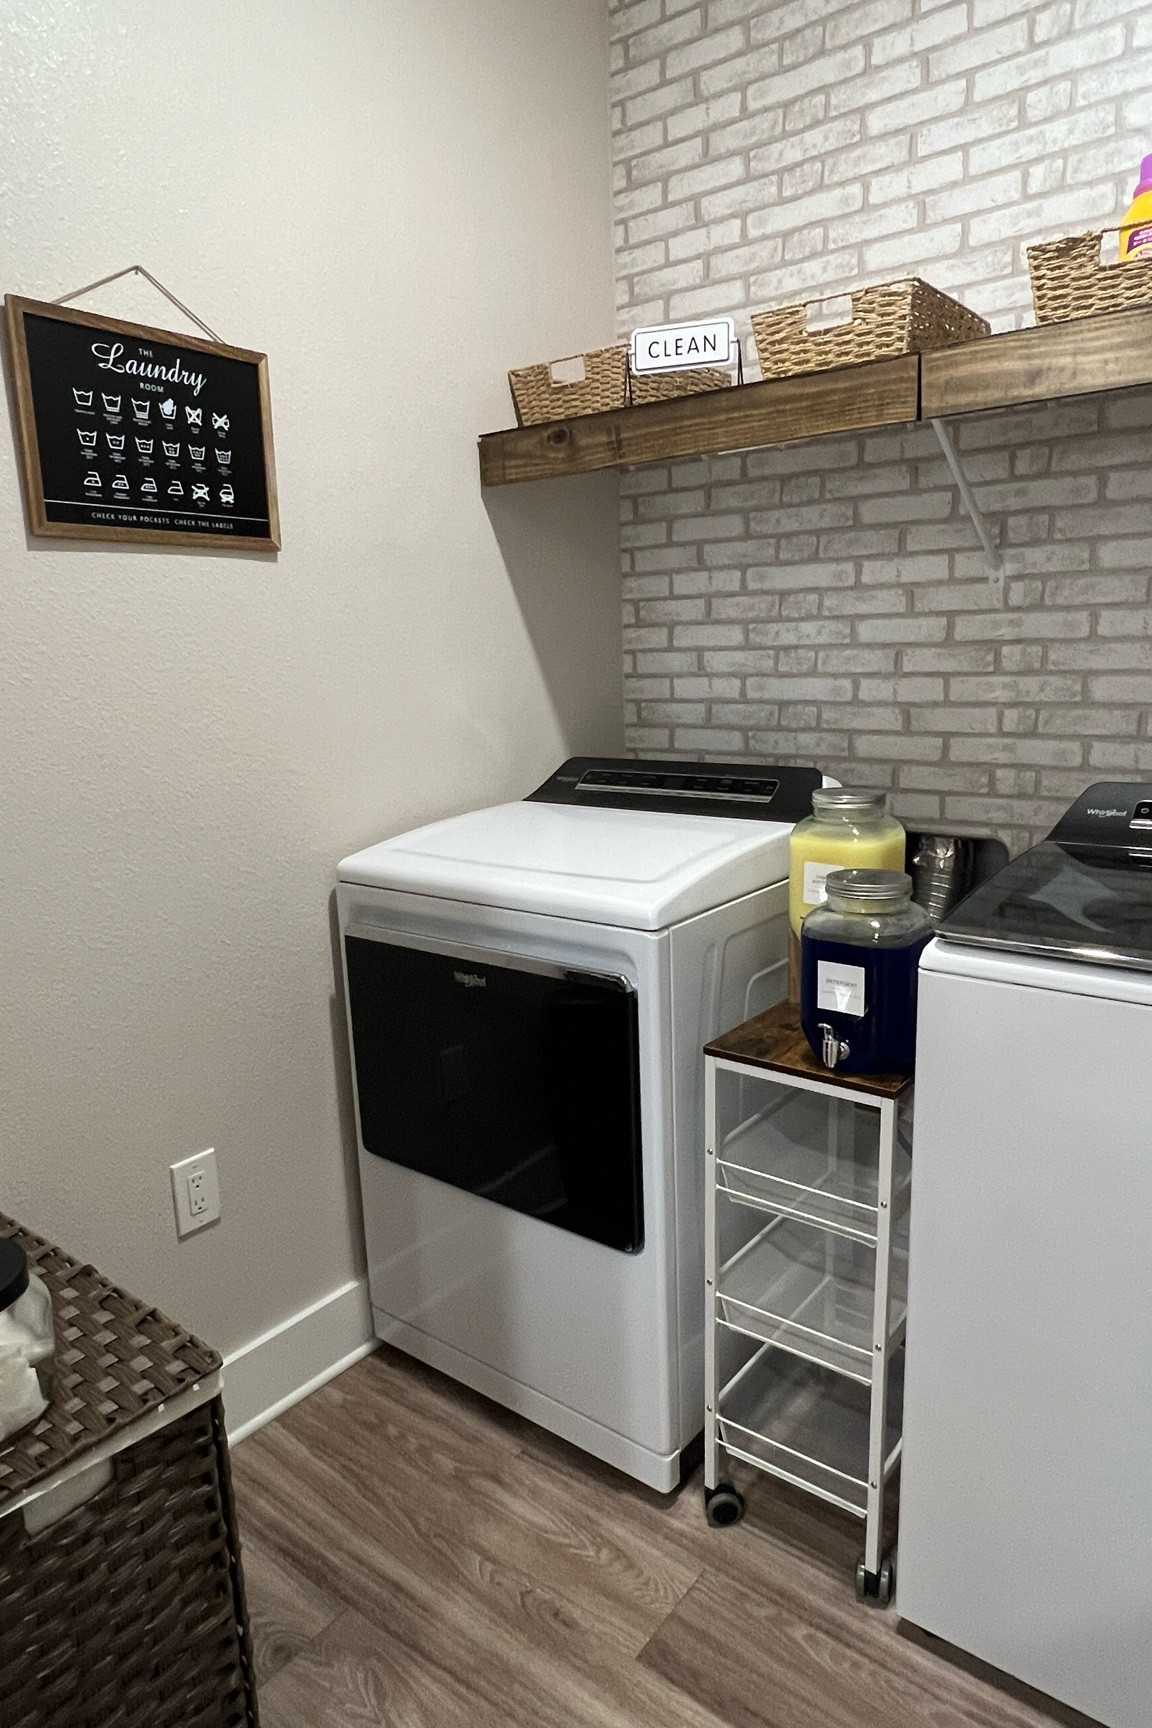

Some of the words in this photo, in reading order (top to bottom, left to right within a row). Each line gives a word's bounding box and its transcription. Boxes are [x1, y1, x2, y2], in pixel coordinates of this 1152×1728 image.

[138, 348, 154, 358] THE
[648, 334, 717, 359] CLEAN
[91, 342, 208, 397] Laundry
[139, 382, 165, 393] ROOM
[91, 512, 116, 520] CHECK
[118, 514, 137, 522] YOUR
[140, 516, 170, 525] POCKETS
[211, 522, 234, 530] LABELS
